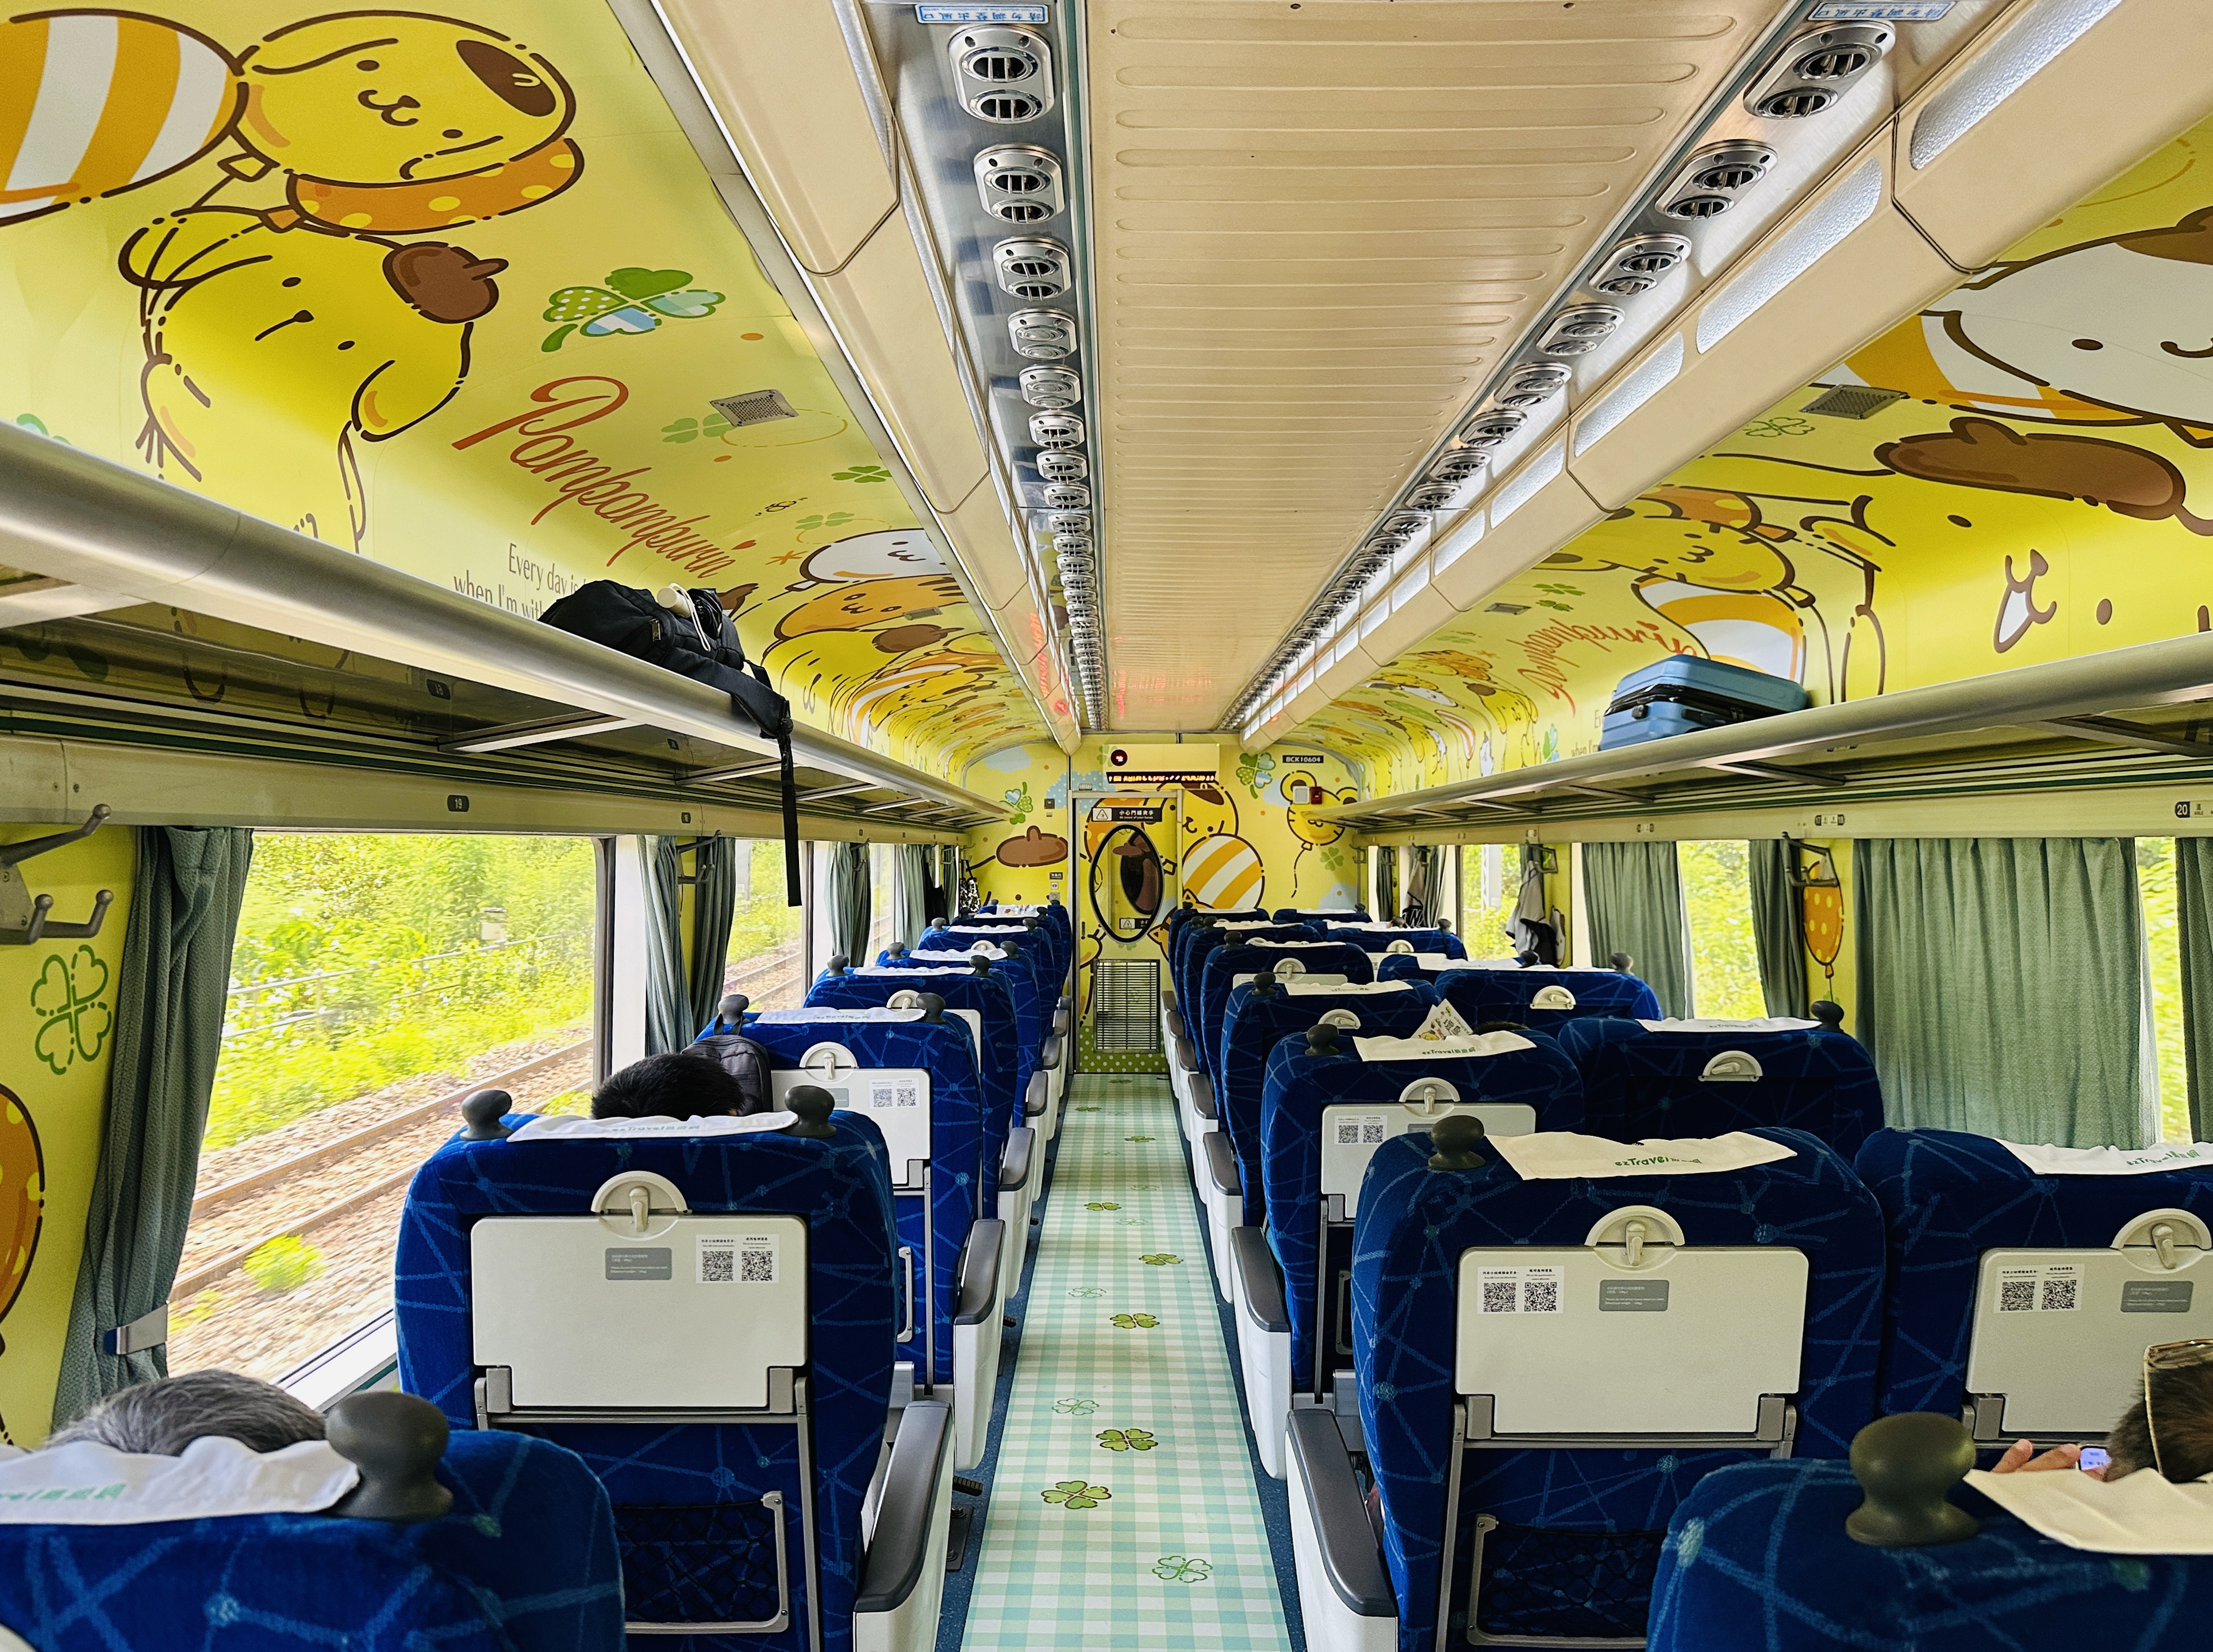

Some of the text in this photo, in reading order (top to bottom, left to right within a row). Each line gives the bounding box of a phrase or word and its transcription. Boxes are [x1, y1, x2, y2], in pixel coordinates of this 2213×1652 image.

[509, 543, 543, 590] Every
[547, 563, 567, 596] day
[454, 570, 493, 604] when
[498, 584, 517, 613] I'm
[455, 798, 462, 809] 19
[2177, 804, 2188, 815] 20
[1615, 1156, 1669, 1166] ezTravel
